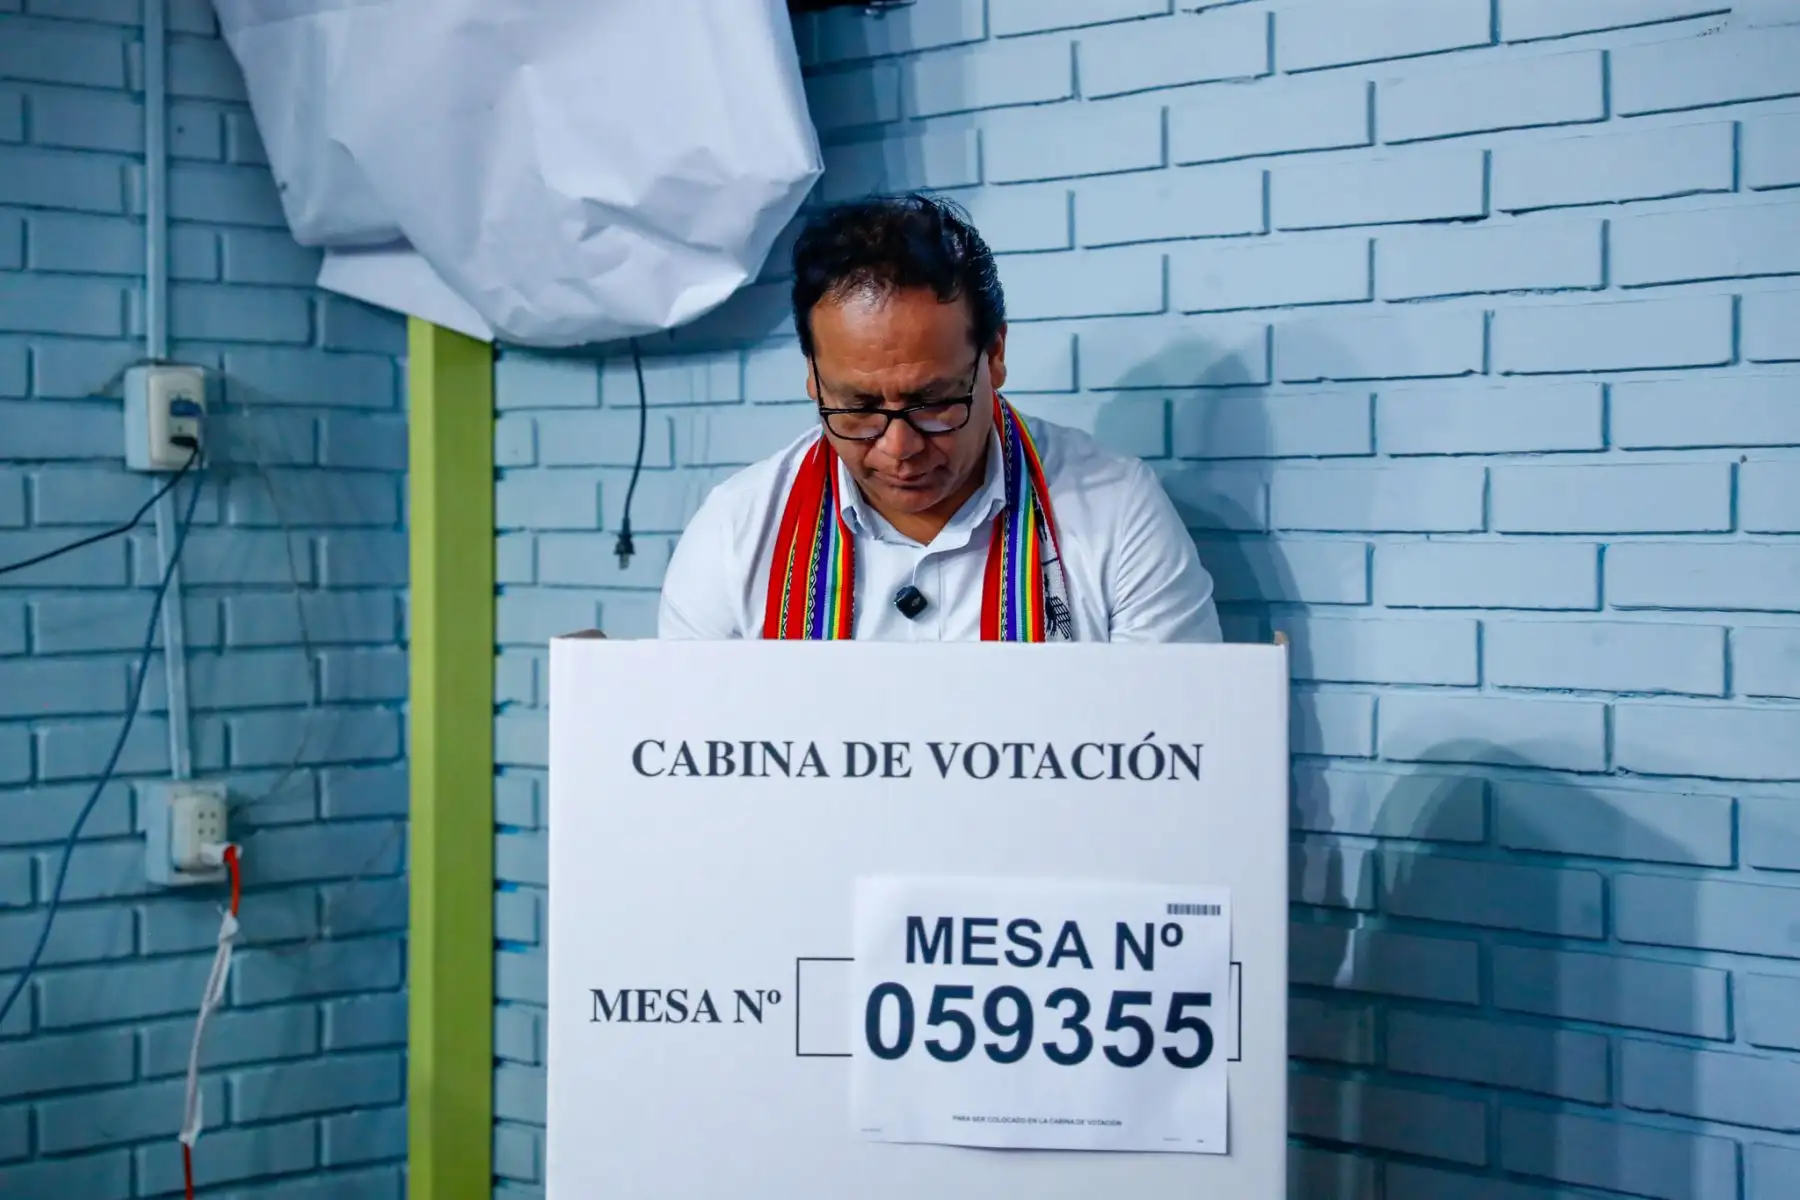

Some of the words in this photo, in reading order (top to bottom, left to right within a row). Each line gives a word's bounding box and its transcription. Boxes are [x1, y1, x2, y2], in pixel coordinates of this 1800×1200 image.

[632, 739, 830, 777] CABINA
[843, 741, 912, 778] DE
[926, 731, 1204, 781] VOTACIÓN
[906, 915, 1094, 970] MESA
[1115, 921, 1184, 972] Nº
[590, 988, 722, 1023] MESA
[733, 989, 782, 1024] Nº
[865, 981, 1214, 1069] 059355
[987, 1116, 1026, 1124] COLOCADO
